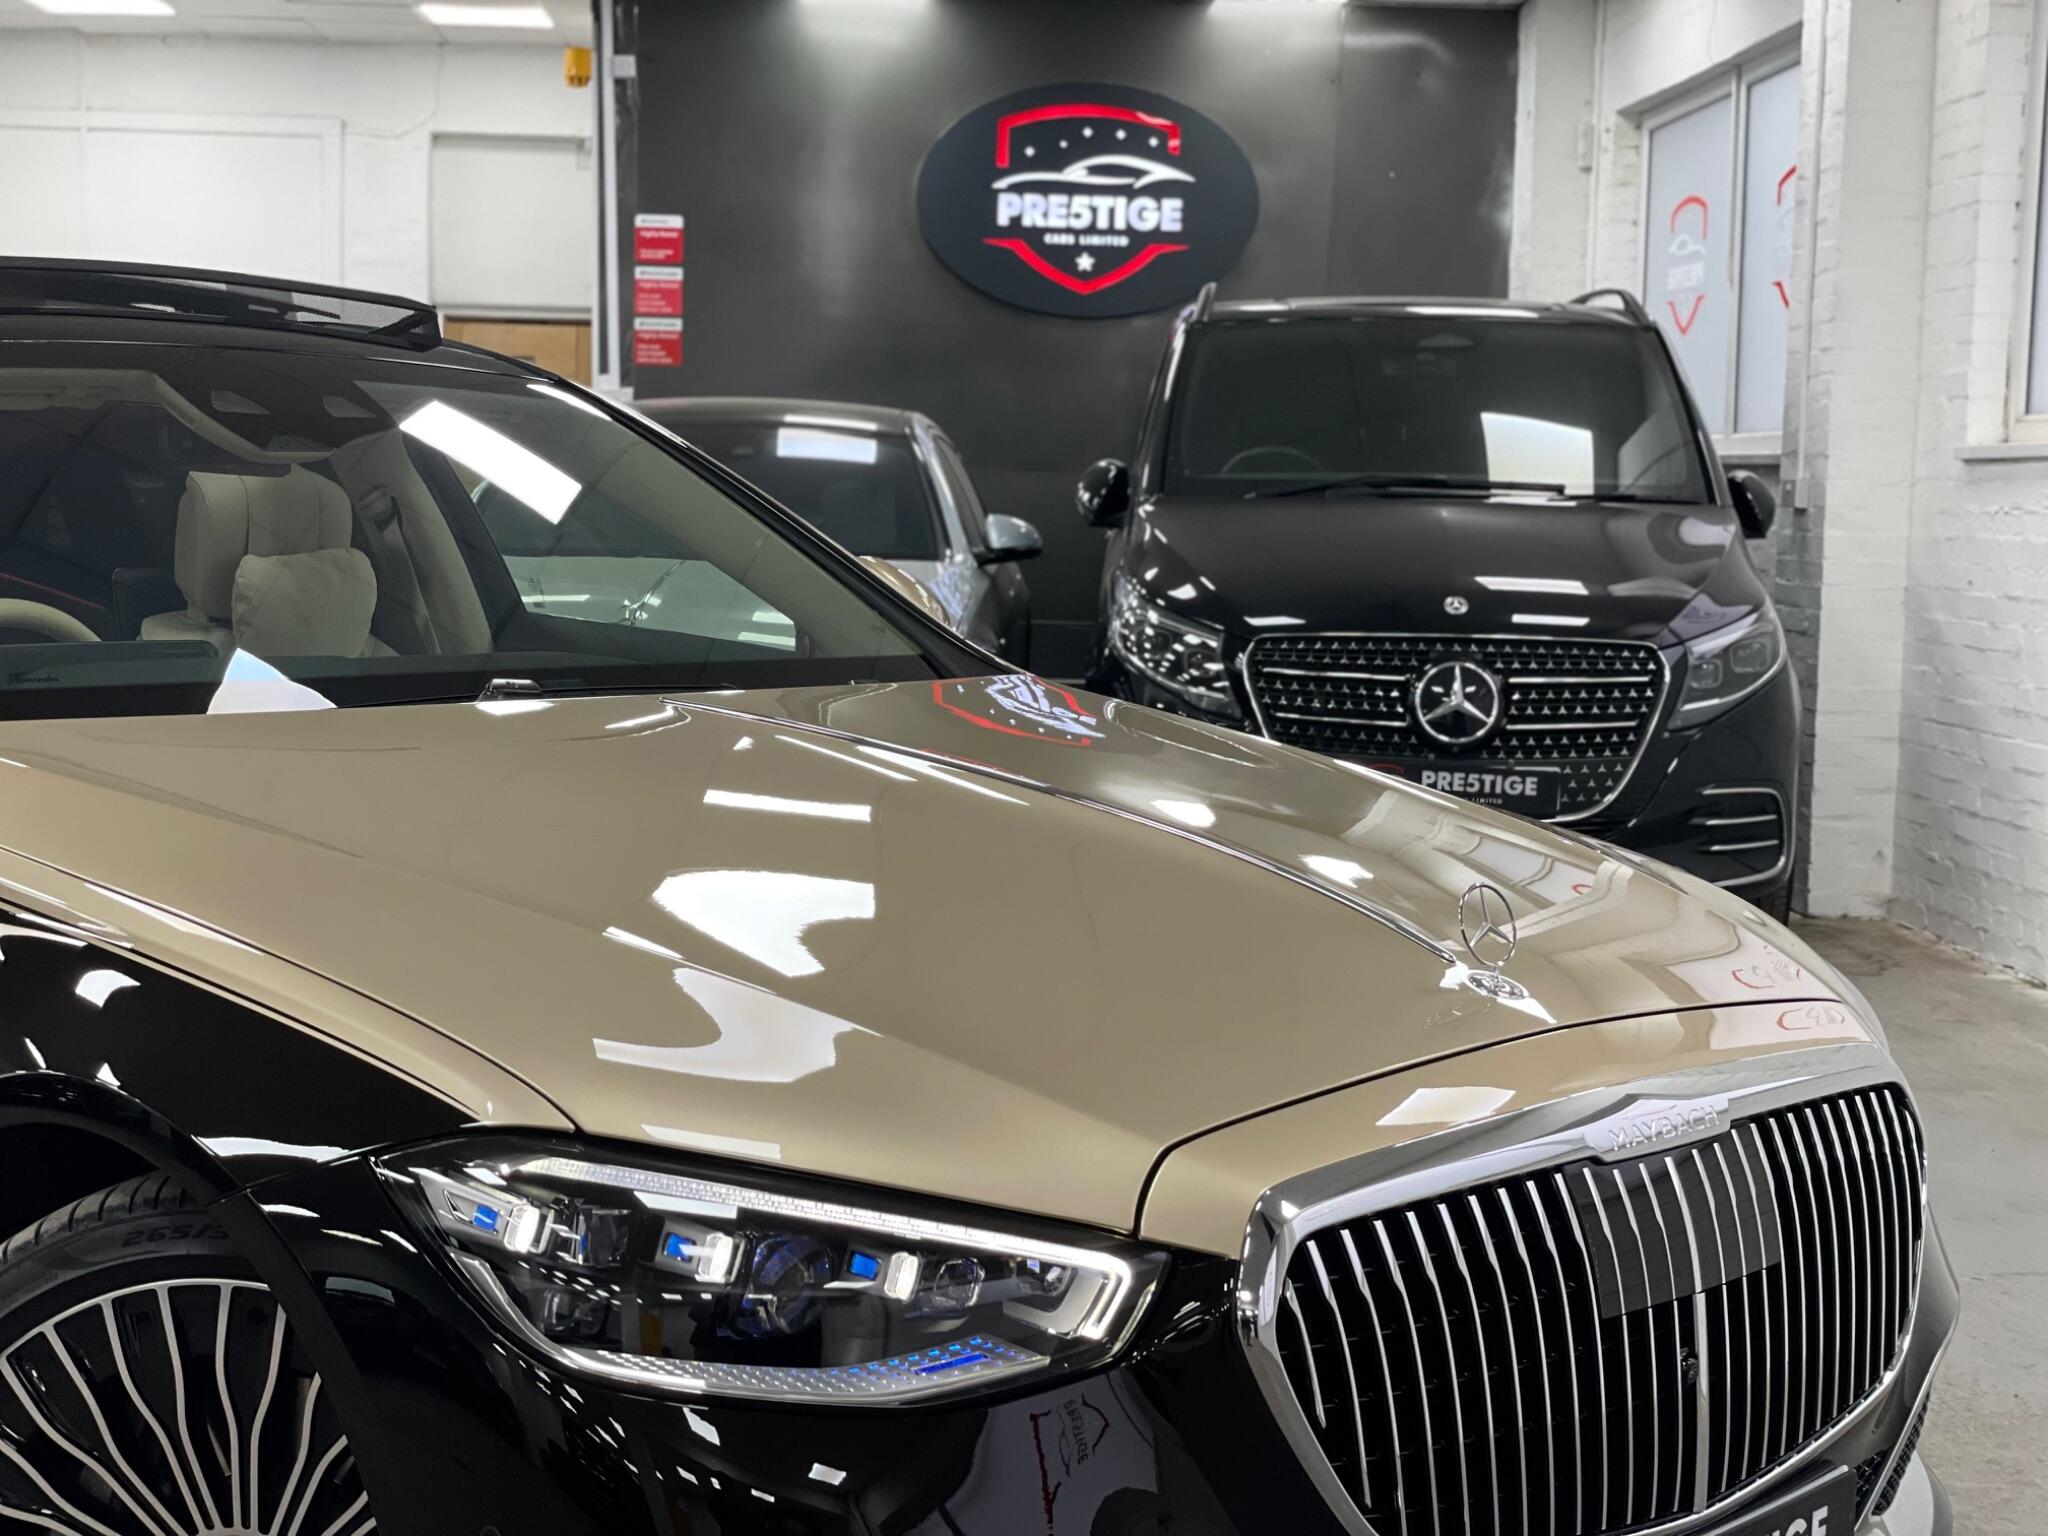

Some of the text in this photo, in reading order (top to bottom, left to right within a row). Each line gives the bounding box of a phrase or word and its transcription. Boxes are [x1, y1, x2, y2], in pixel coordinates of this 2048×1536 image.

[996, 192, 1184, 232] PRE5TIGE
[1078, 234, 1130, 247] LIMITED
[1423, 770, 1538, 796] PRE5TIGE
[1608, 1104, 1720, 1151] MAYBACH
